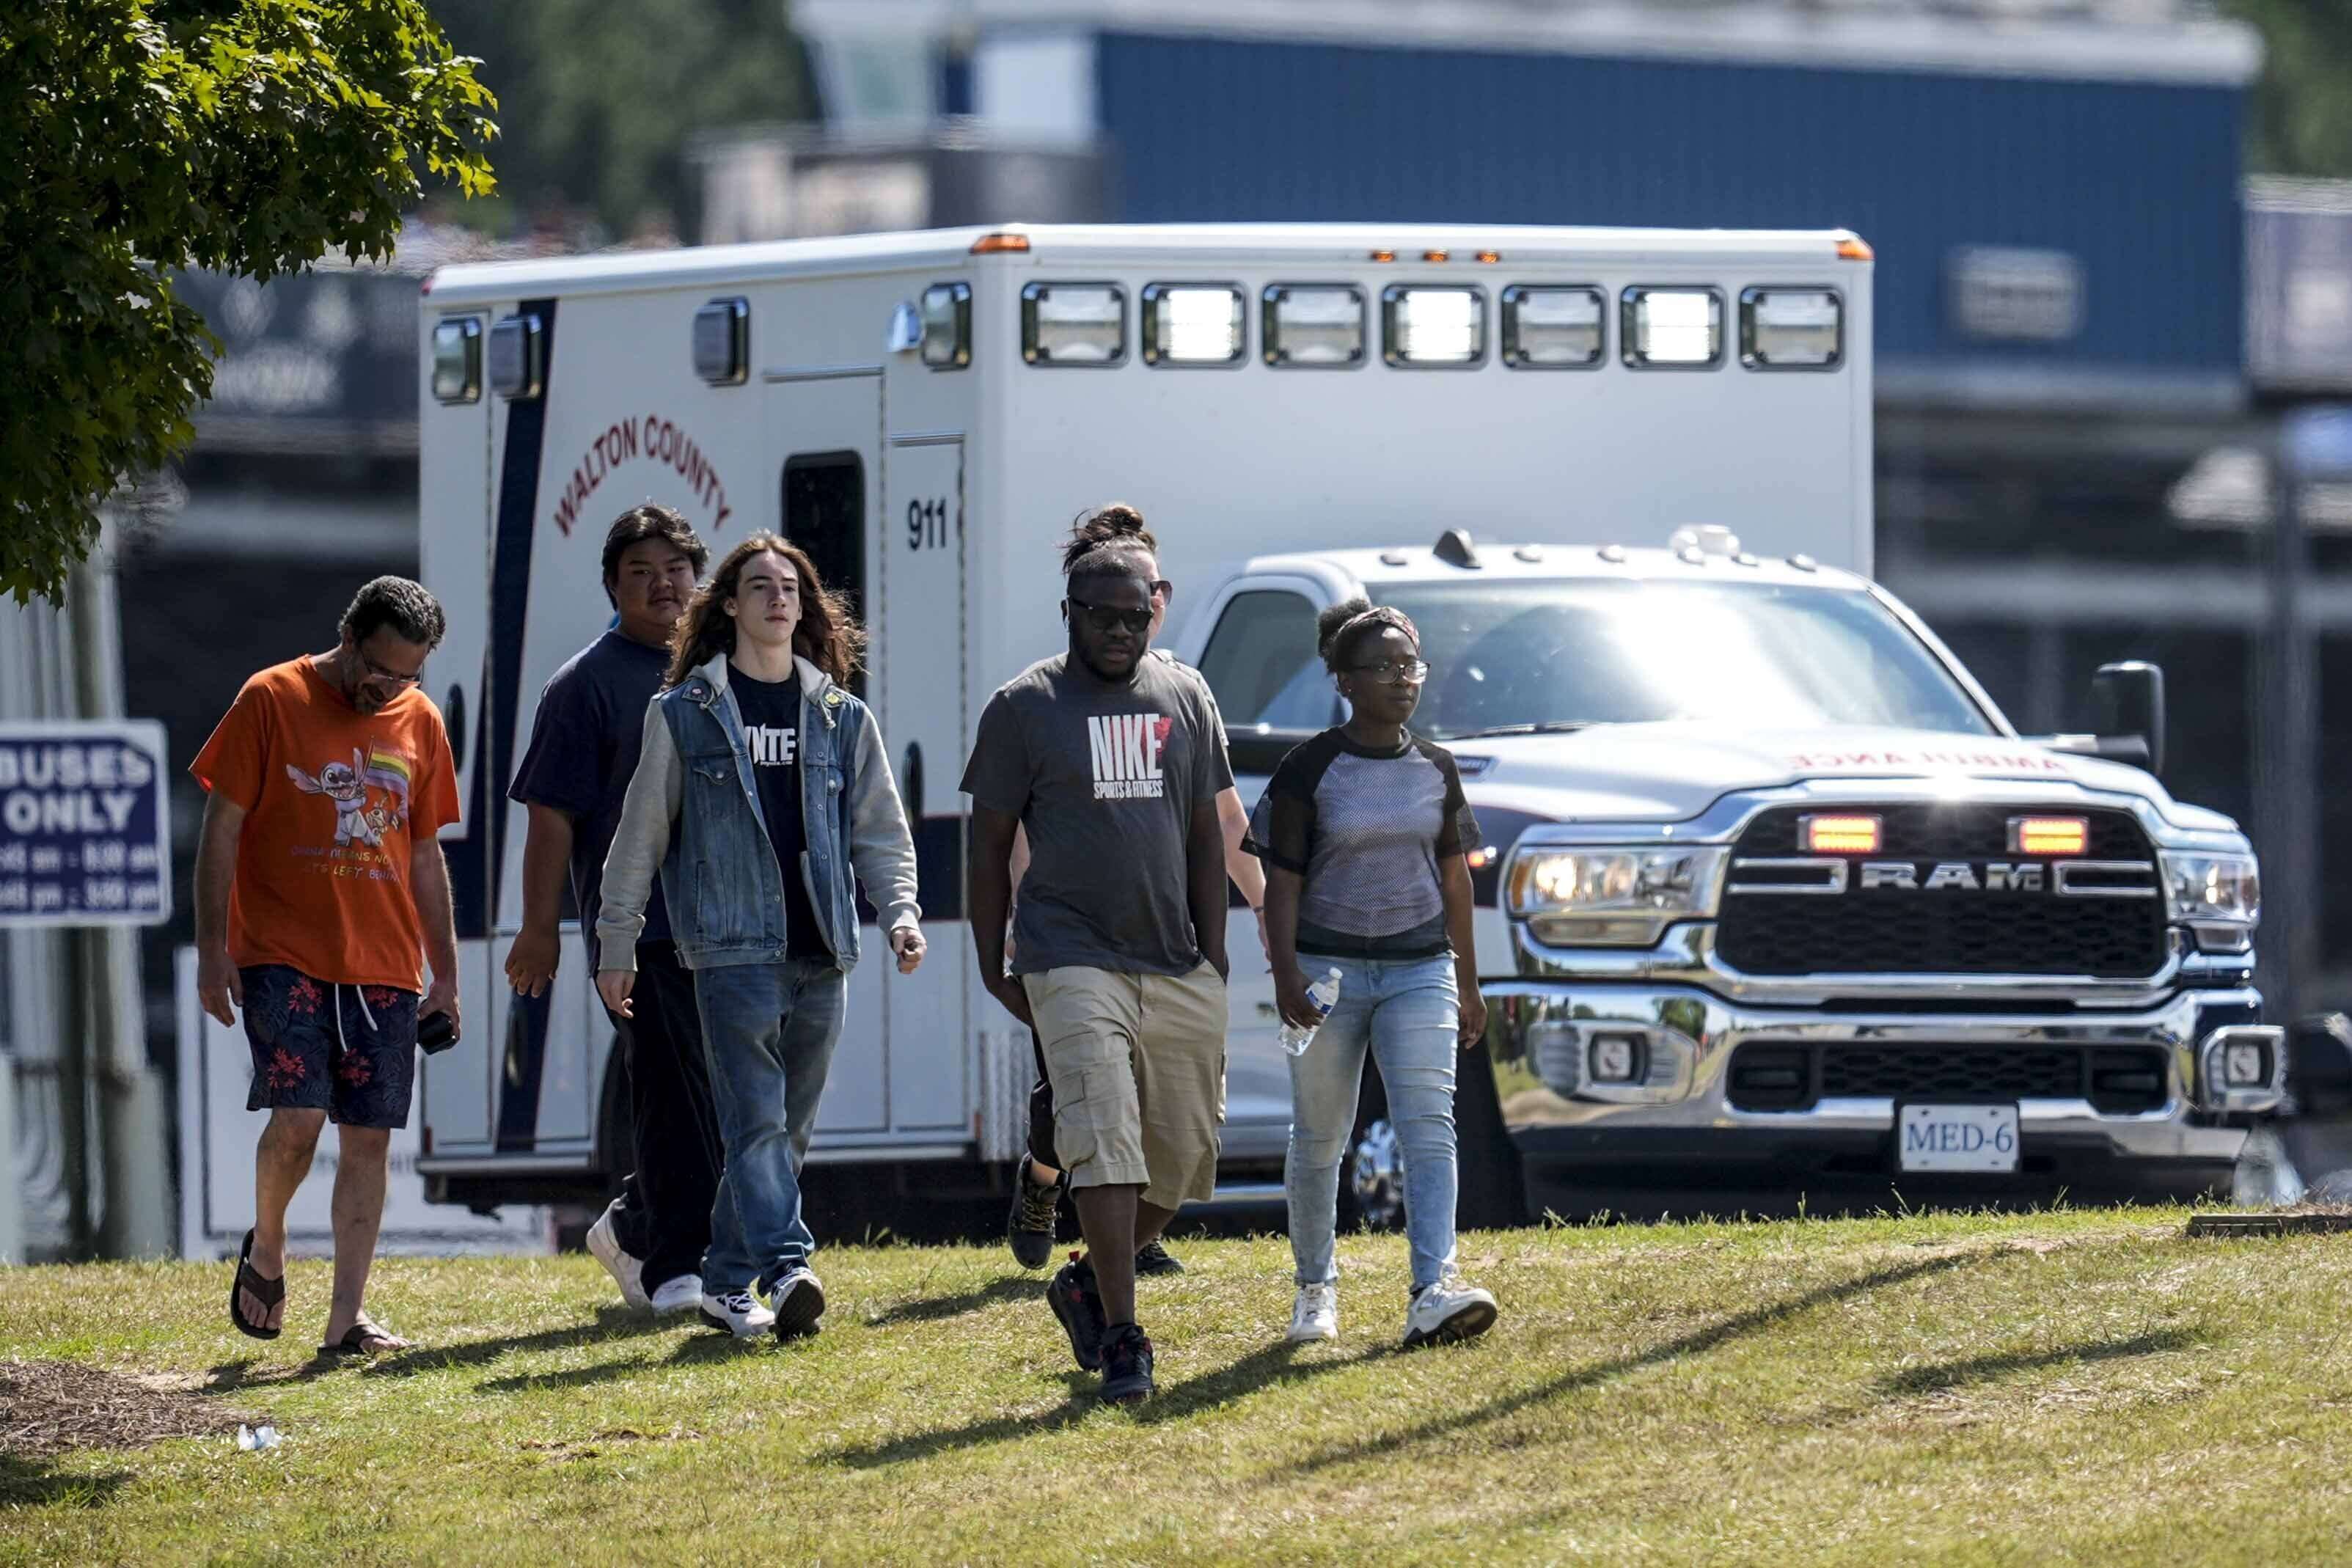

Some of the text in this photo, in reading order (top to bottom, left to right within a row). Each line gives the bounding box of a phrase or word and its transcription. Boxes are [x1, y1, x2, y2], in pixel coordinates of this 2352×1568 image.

[554, 414, 732, 538] WALTON COUNTY
[908, 498, 946, 551] 911
[0, 745, 152, 789] BUSES
[1088, 714, 1163, 781] NIKE
[1093, 781, 1125, 799] SPORTS
[4, 790, 138, 835] ONLY
[369, 868, 400, 882] BEHIN
[1861, 862, 2044, 890] RAM
[1907, 1121, 2013, 1154] MED-6
